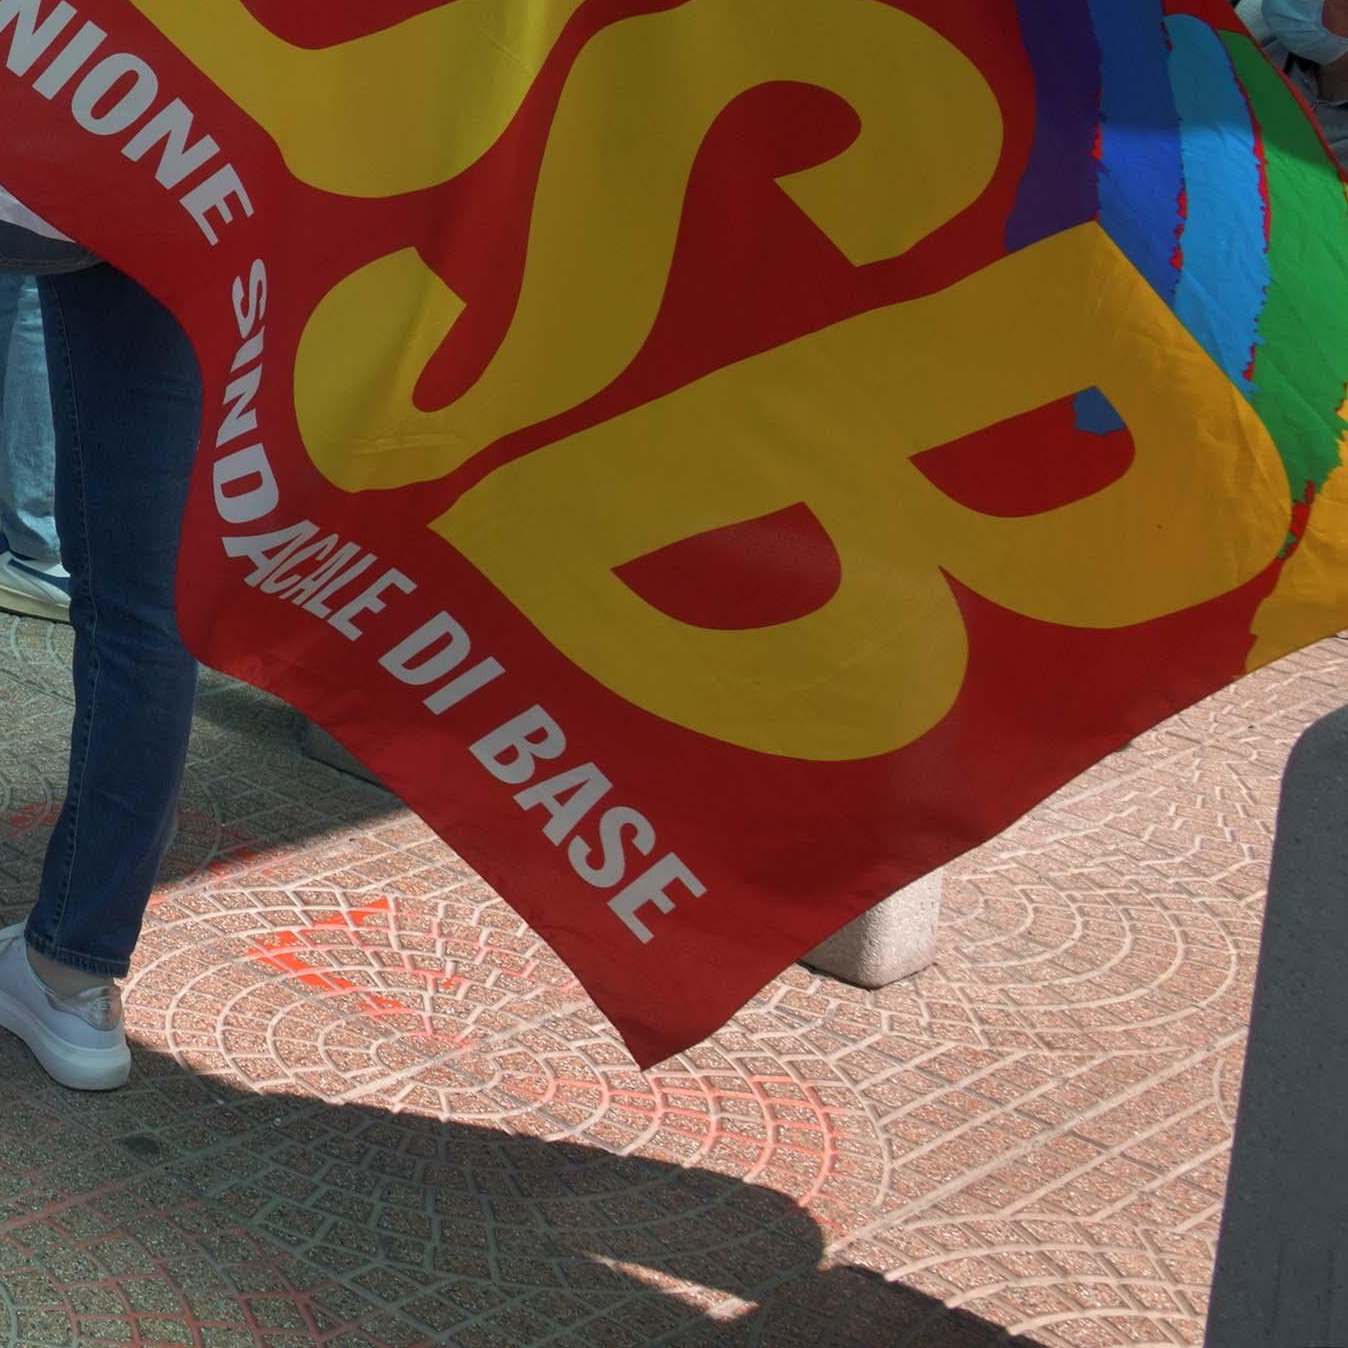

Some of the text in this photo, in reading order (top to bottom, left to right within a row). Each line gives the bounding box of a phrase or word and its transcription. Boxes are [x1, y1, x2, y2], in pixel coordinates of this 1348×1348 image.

[212, 257, 418, 642] SINDACALE
[378, 611, 505, 715] DI
[469, 703, 708, 944] BASE
